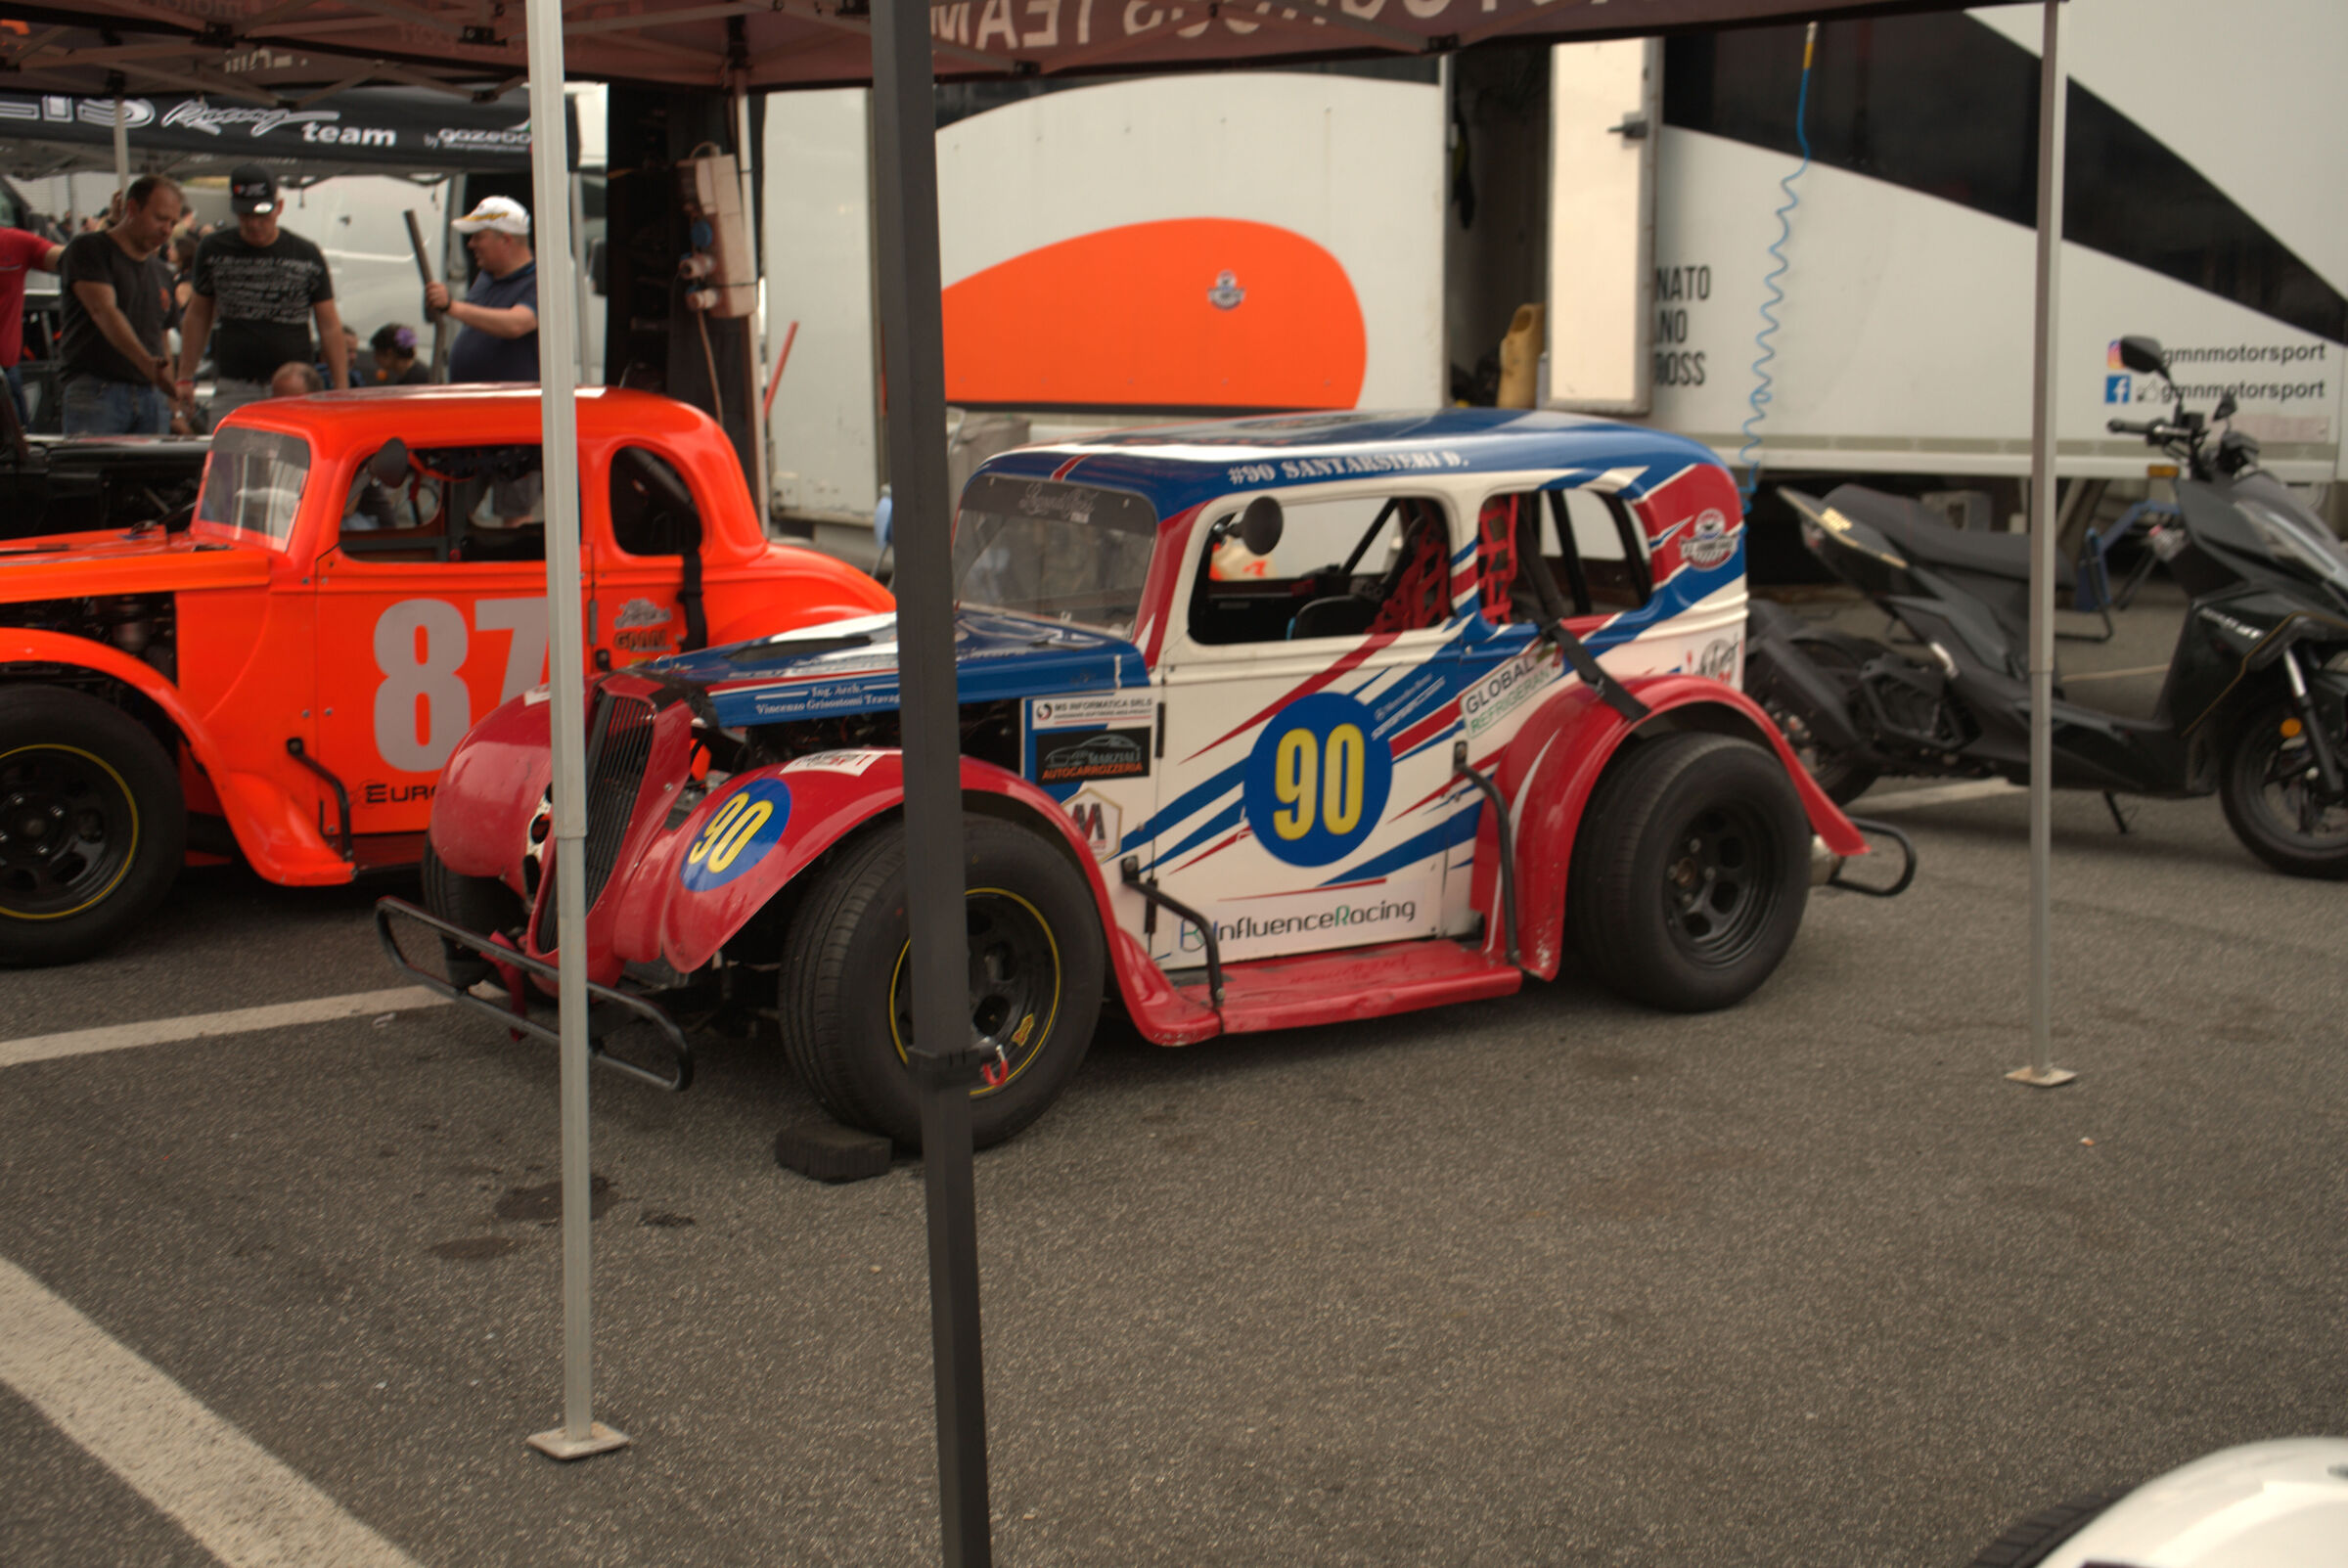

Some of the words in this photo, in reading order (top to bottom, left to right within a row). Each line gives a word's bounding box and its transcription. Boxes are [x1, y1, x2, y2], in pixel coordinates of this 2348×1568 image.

[301, 121, 397, 147] team
[2161, 342, 2325, 366] gmnmotorsport
[2160, 381, 2325, 404] gmnmotorsport
[1228, 463, 1276, 485] #90
[1280, 451, 1440, 479] SANTARSIERI
[1440, 450, 1469, 468] D.
[373, 596, 550, 773] 87
[1466, 657, 1534, 714] GLOBAL
[1273, 723, 1365, 841] 90
[688, 791, 774, 874] 90
